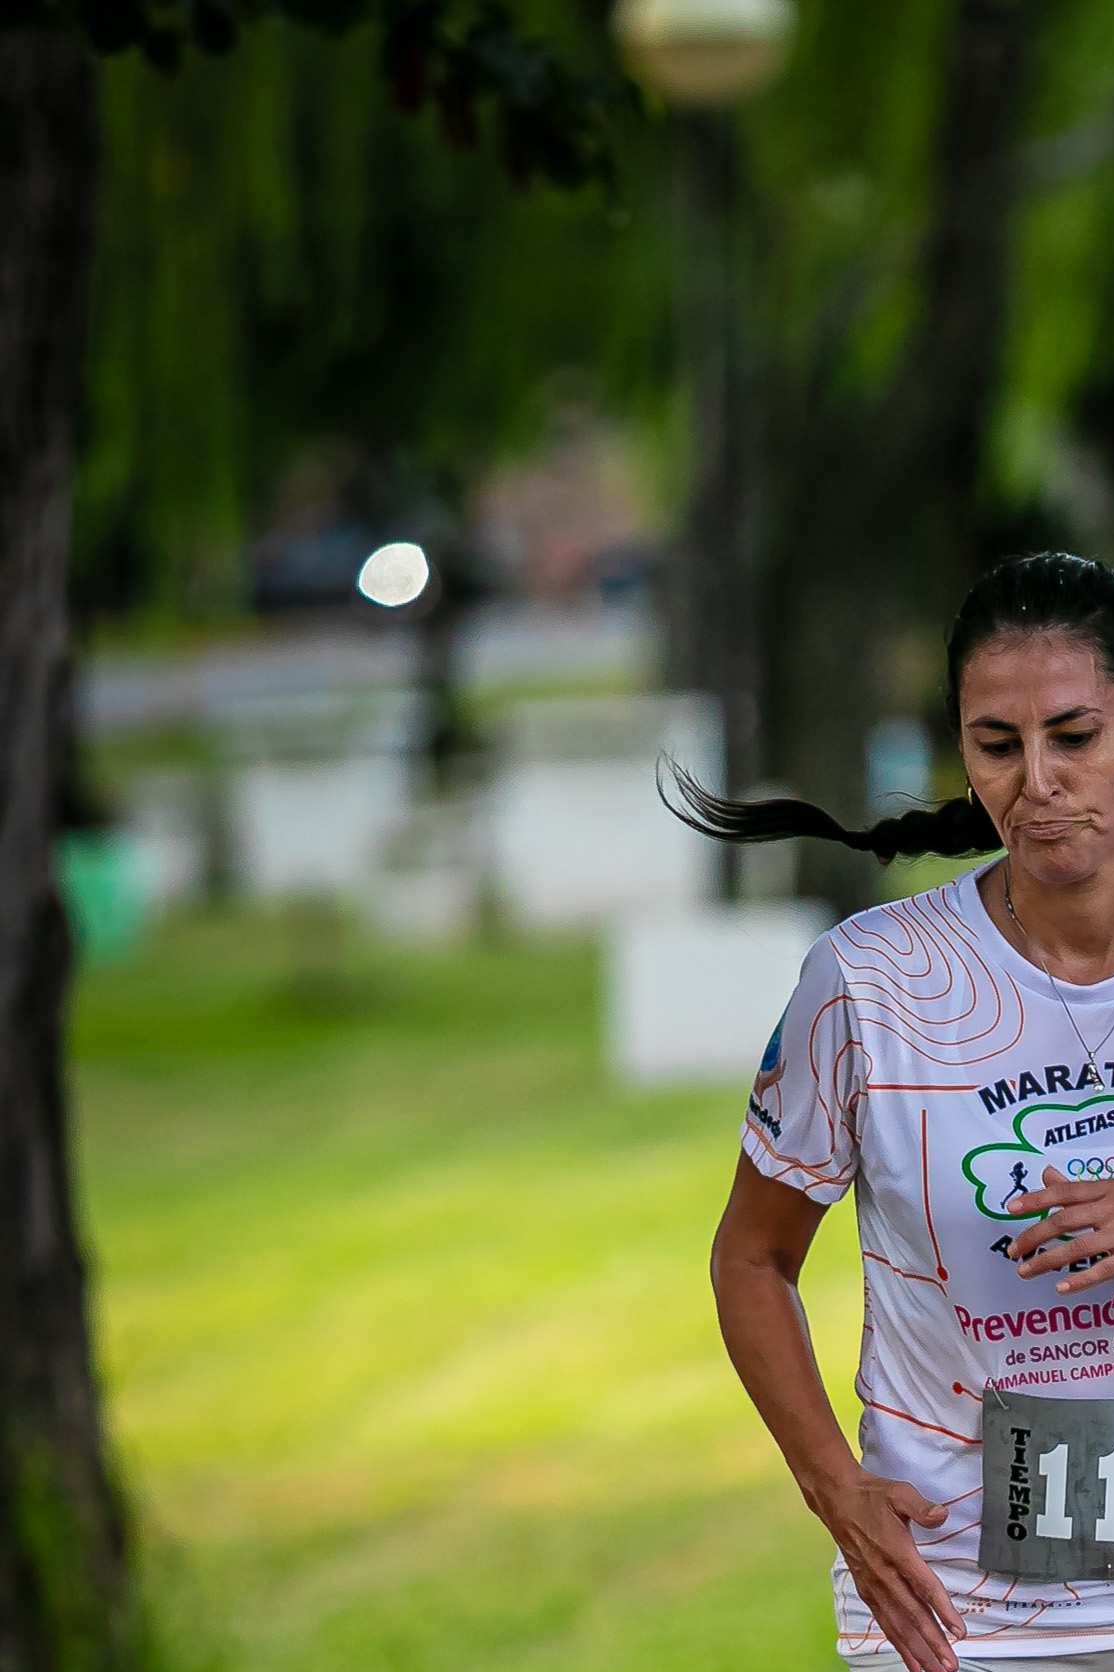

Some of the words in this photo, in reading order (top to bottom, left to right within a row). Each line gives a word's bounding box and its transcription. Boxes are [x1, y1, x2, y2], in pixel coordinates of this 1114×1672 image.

[1005, 1349, 1026, 1366] de
[1030, 1339, 1109, 1363] SANCOR
[1007, 1427, 1031, 1542] TIEMPO
